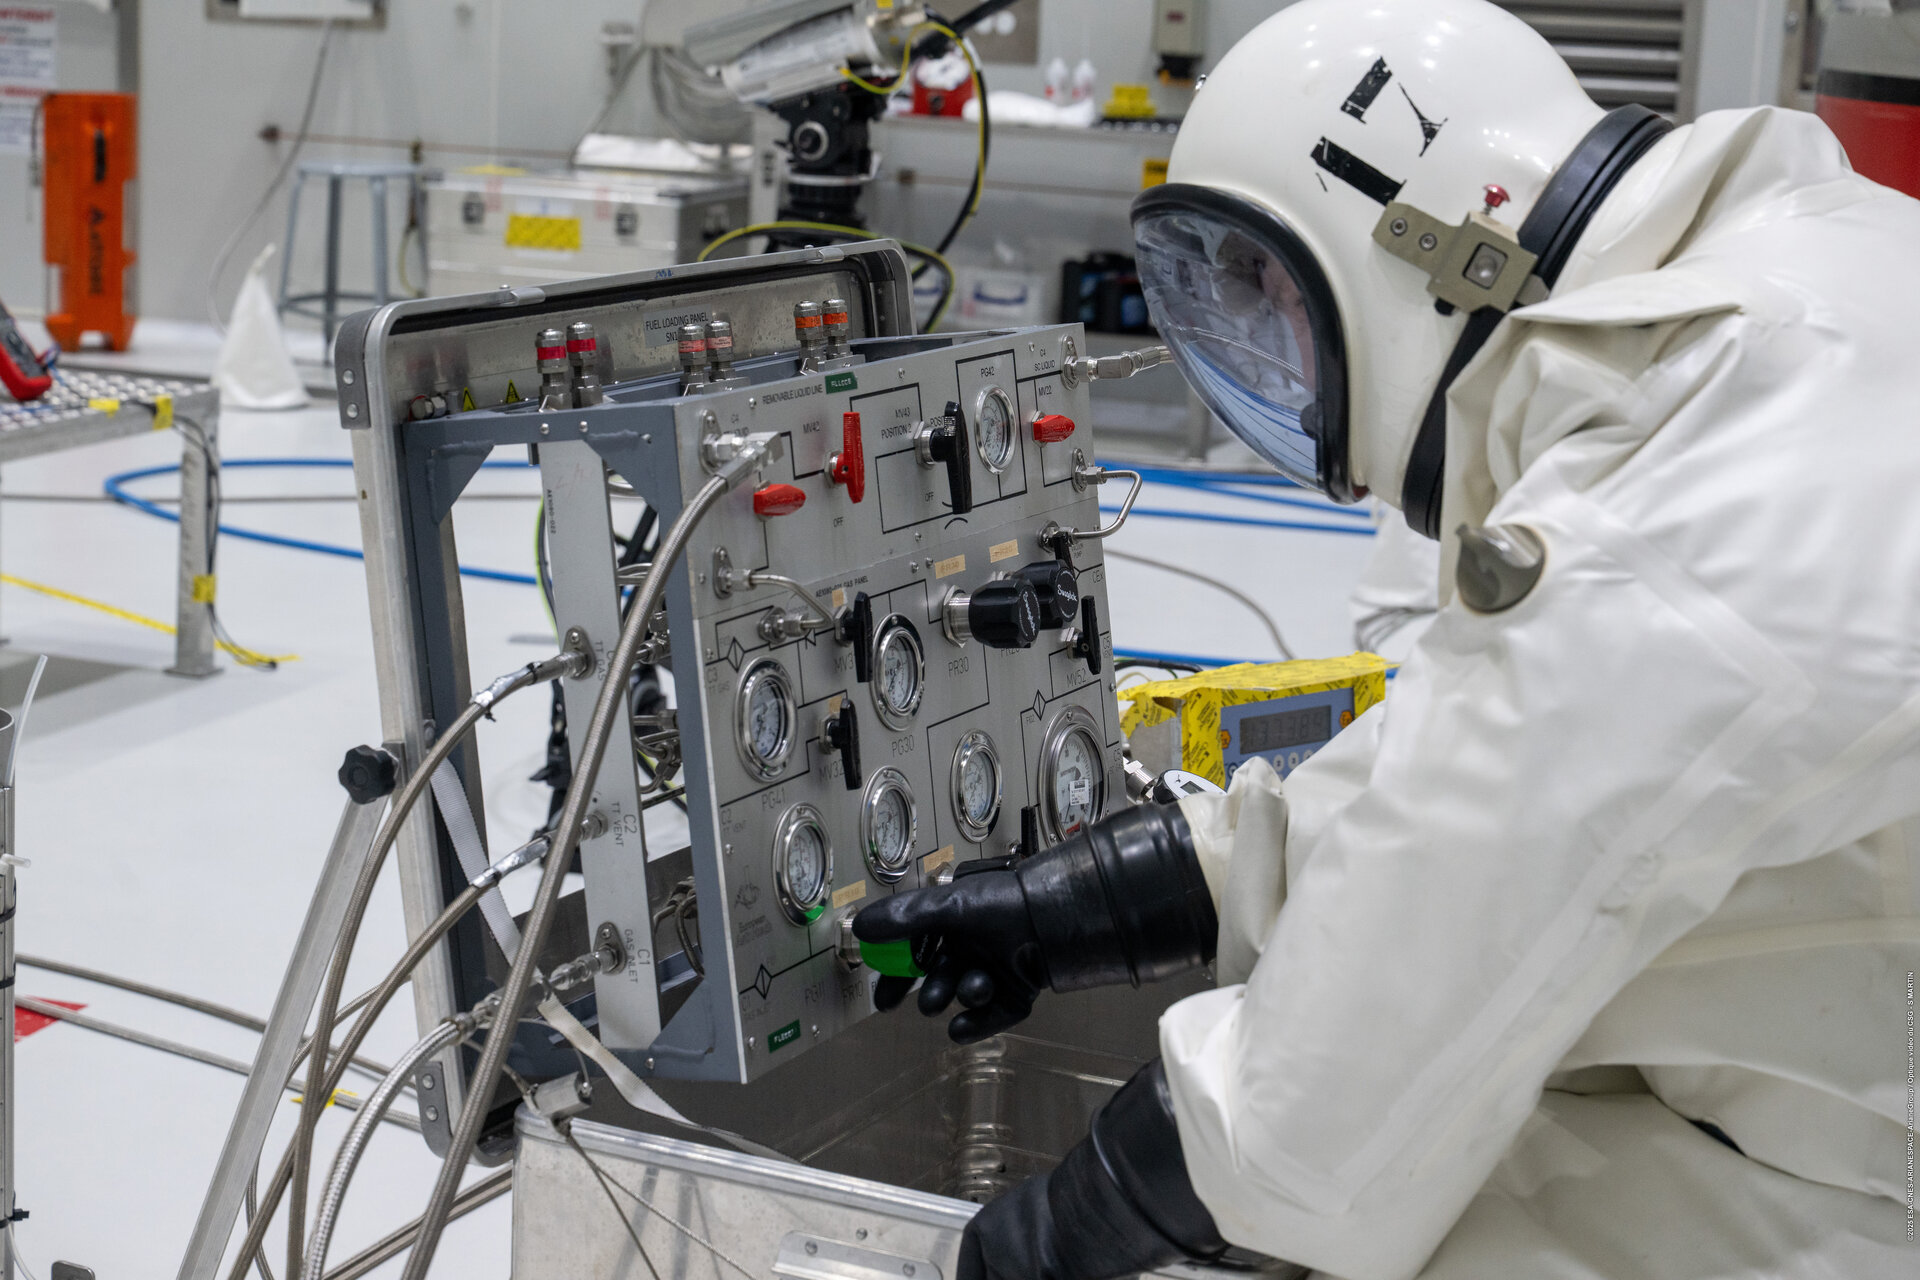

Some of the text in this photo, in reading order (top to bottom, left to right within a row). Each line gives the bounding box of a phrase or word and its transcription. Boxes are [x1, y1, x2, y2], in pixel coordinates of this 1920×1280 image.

[645, 311, 708, 331] FUEL LOADING PANEL
[980, 366, 995, 378] PG42
[762, 384, 824, 405] REMOVABLE LIQUID LINE
[802, 420, 820, 434] MV42
[881, 426, 908, 440] POSITION
[924, 492, 935, 502] OFF
[833, 516, 844, 528] OFF
[854, 574, 869, 586] PANEL
[948, 656, 970, 678] PR30
[892, 734, 915, 756] PG30
[762, 788, 786, 811] PG41
[610, 801, 624, 848] TT VENT
[622, 814, 639, 834] C2
[624, 929, 636, 951] GAS
[637, 948, 651, 966] C1
